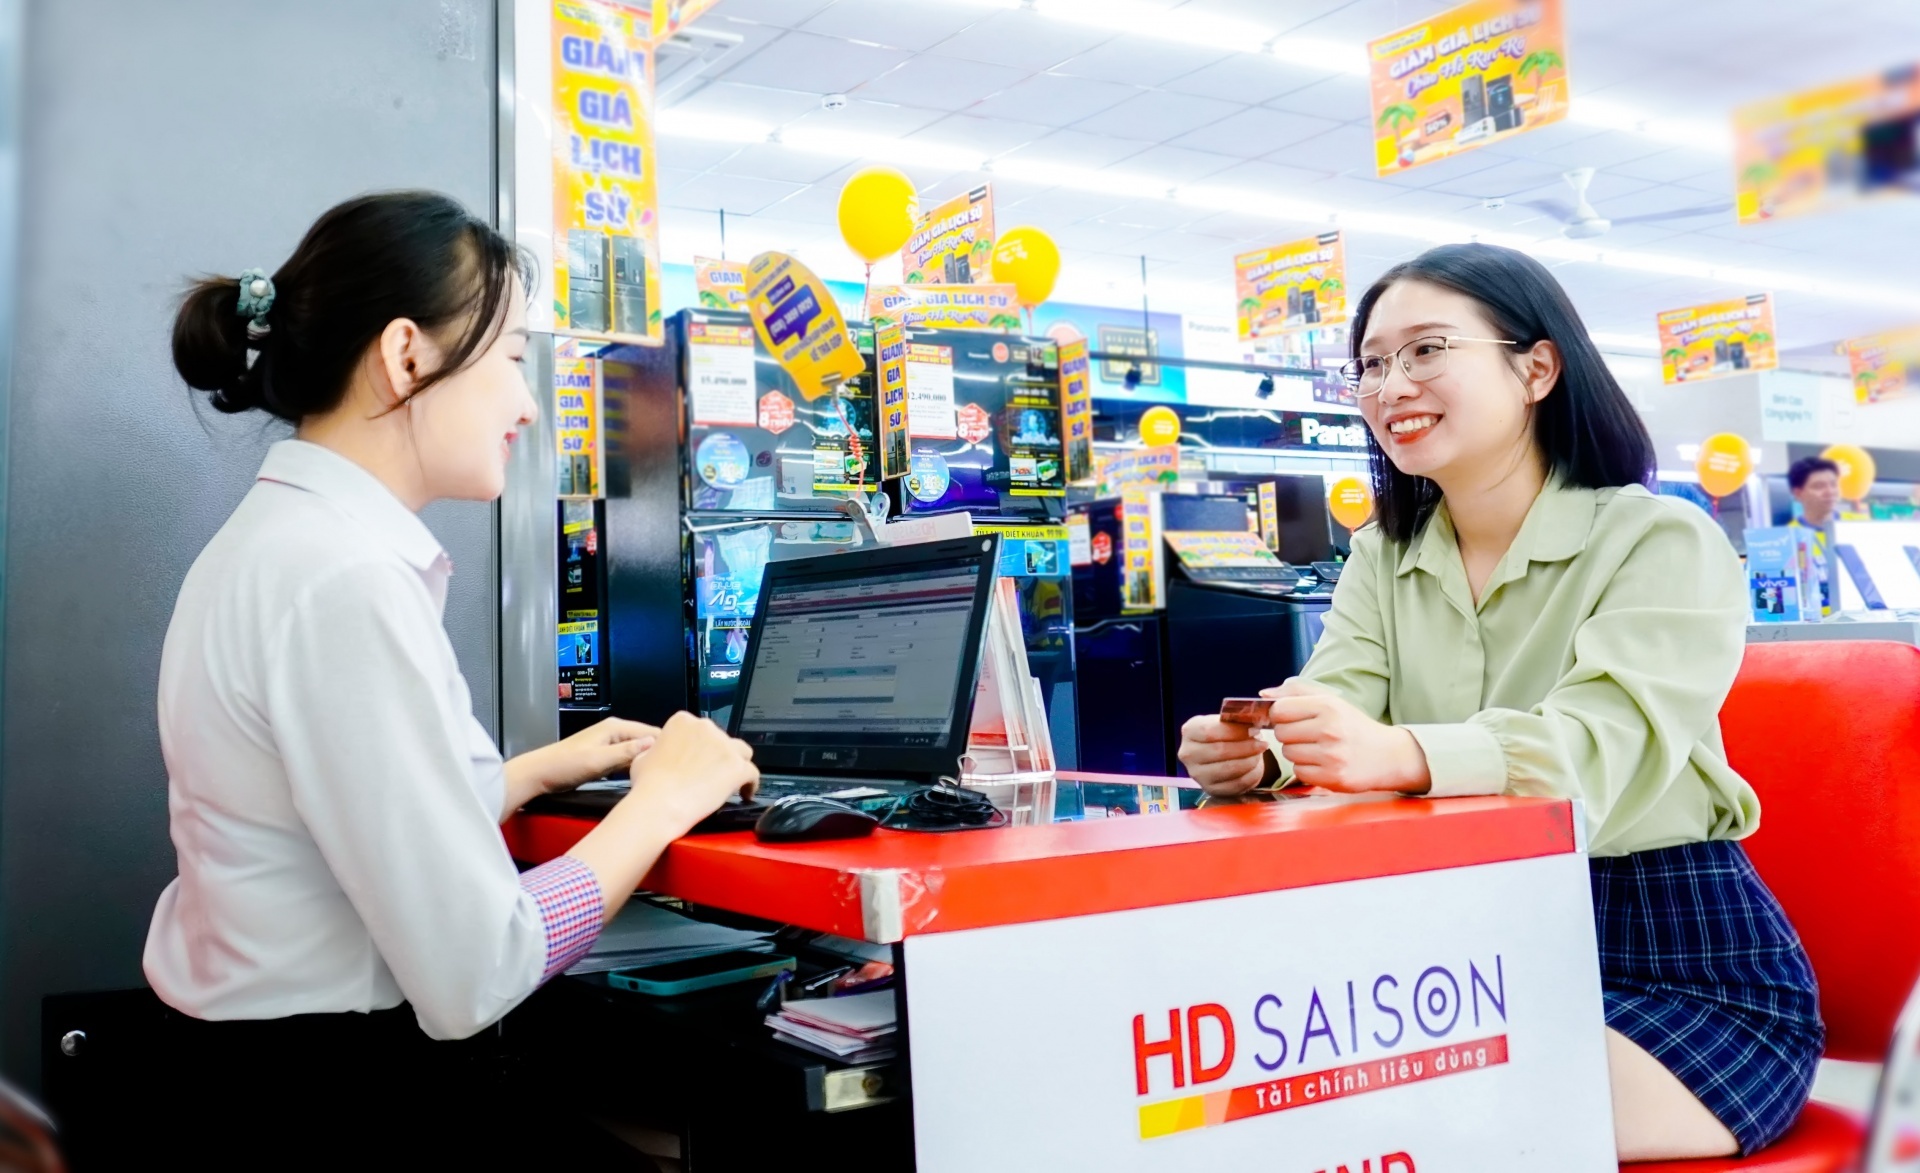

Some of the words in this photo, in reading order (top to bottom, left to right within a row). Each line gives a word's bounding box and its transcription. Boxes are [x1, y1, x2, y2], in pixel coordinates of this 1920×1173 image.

[562, 36, 645, 77] GIẢM
[1390, 45, 1435, 79] GIẢM
[1439, 26, 1469, 56] GIÁ
[1472, 13, 1513, 45] LỊCH
[579, 90, 633, 127] GIÁ
[570, 135, 642, 176] LỊCH
[910, 231, 932, 254] GIẢM
[932, 219, 948, 239] GIÁ
[948, 212, 969, 232] LỊCH
[882, 343, 903, 362] GIẢM
[887, 365, 901, 383] GIÁ
[559, 395, 585, 410] GIÁ
[885, 387, 904, 406] LỊCH
[890, 408, 901, 428] SỬ
[1758, 580, 1788, 588] vivo
[1132, 1002, 1235, 1095] HD
[1254, 954, 1508, 1071] SAISON
[1256, 1087, 1292, 1110] Tài
[1304, 1069, 1369, 1099] chính
[1380, 1058, 1423, 1083] tiêu
[1435, 1045, 1488, 1073] dùng
